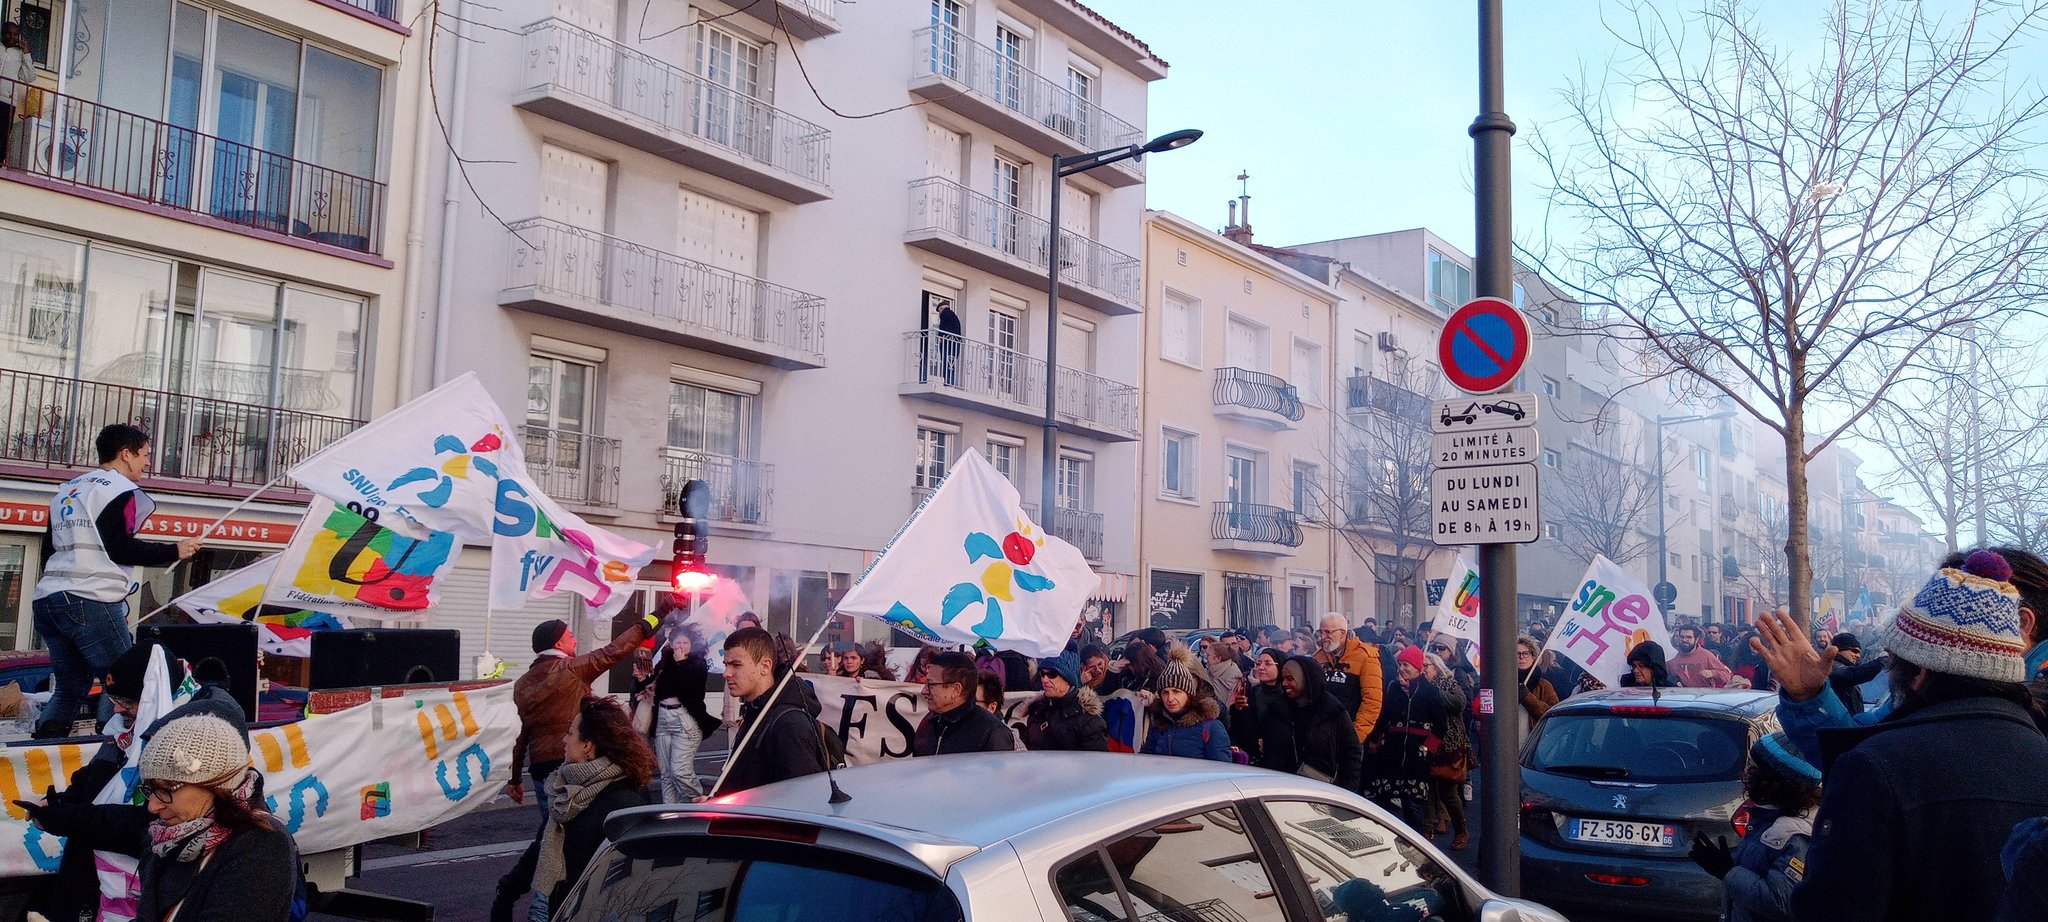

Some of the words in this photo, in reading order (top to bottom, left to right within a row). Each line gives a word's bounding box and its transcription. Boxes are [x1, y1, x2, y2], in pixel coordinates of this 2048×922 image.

[1453, 433, 1498, 447] LIMITÉ
[1506, 432, 1513, 444] À
[1442, 452, 1457, 461] 20
[1464, 447, 1526, 460] MINUTES
[1447, 479, 1466, 490] DU
[1473, 475, 1519, 489] LUNDI
[1441, 500, 1460, 512] AU
[1467, 497, 1527, 511] SAMEDI
[142, 519, 269, 539] ASSURANCE
[1438, 522, 1457, 534] DE
[1464, 521, 1480, 533] 8h
[1488, 518, 1497, 532] À
[1504, 519, 1531, 532] 19h
[1581, 821, 1661, 842] FZ-536-GX
[1663, 836, 1673, 844] 66
